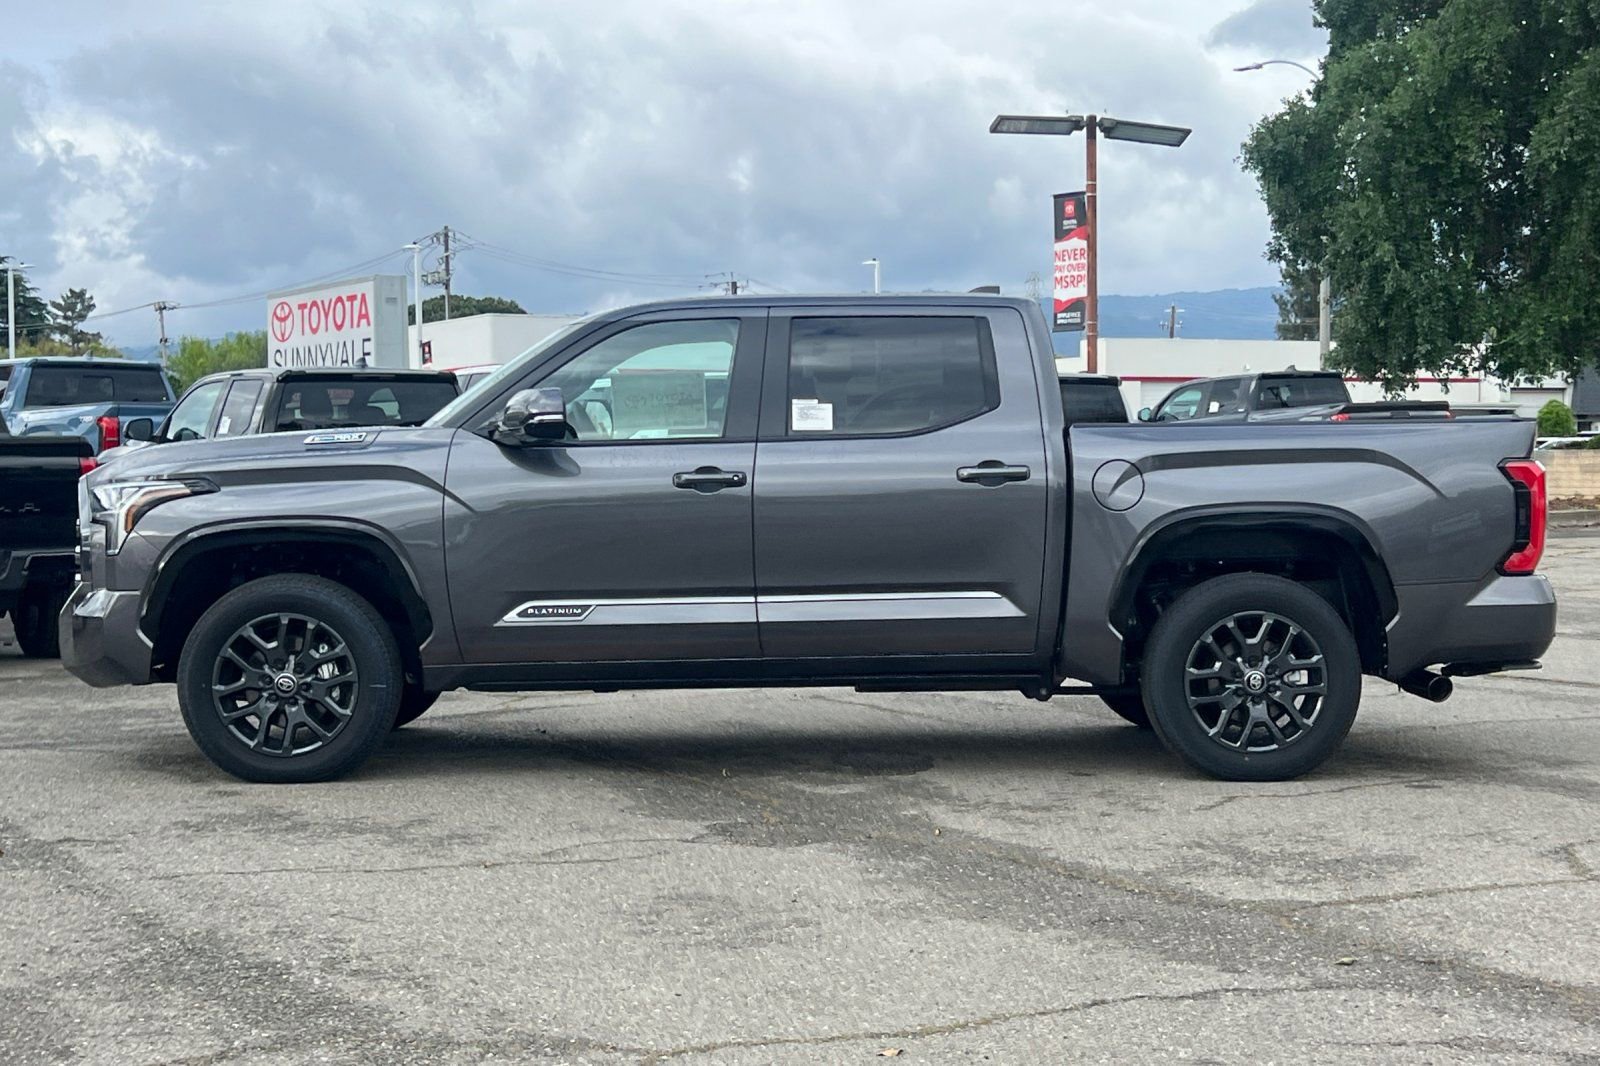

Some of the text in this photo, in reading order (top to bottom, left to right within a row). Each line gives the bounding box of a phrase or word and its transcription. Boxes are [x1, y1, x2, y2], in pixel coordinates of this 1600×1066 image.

[1054, 247, 1086, 262] NEVER
[1066, 263, 1086, 273] OVER
[1054, 273, 1086, 289] MSRP!
[297, 292, 371, 336] TOYOTA
